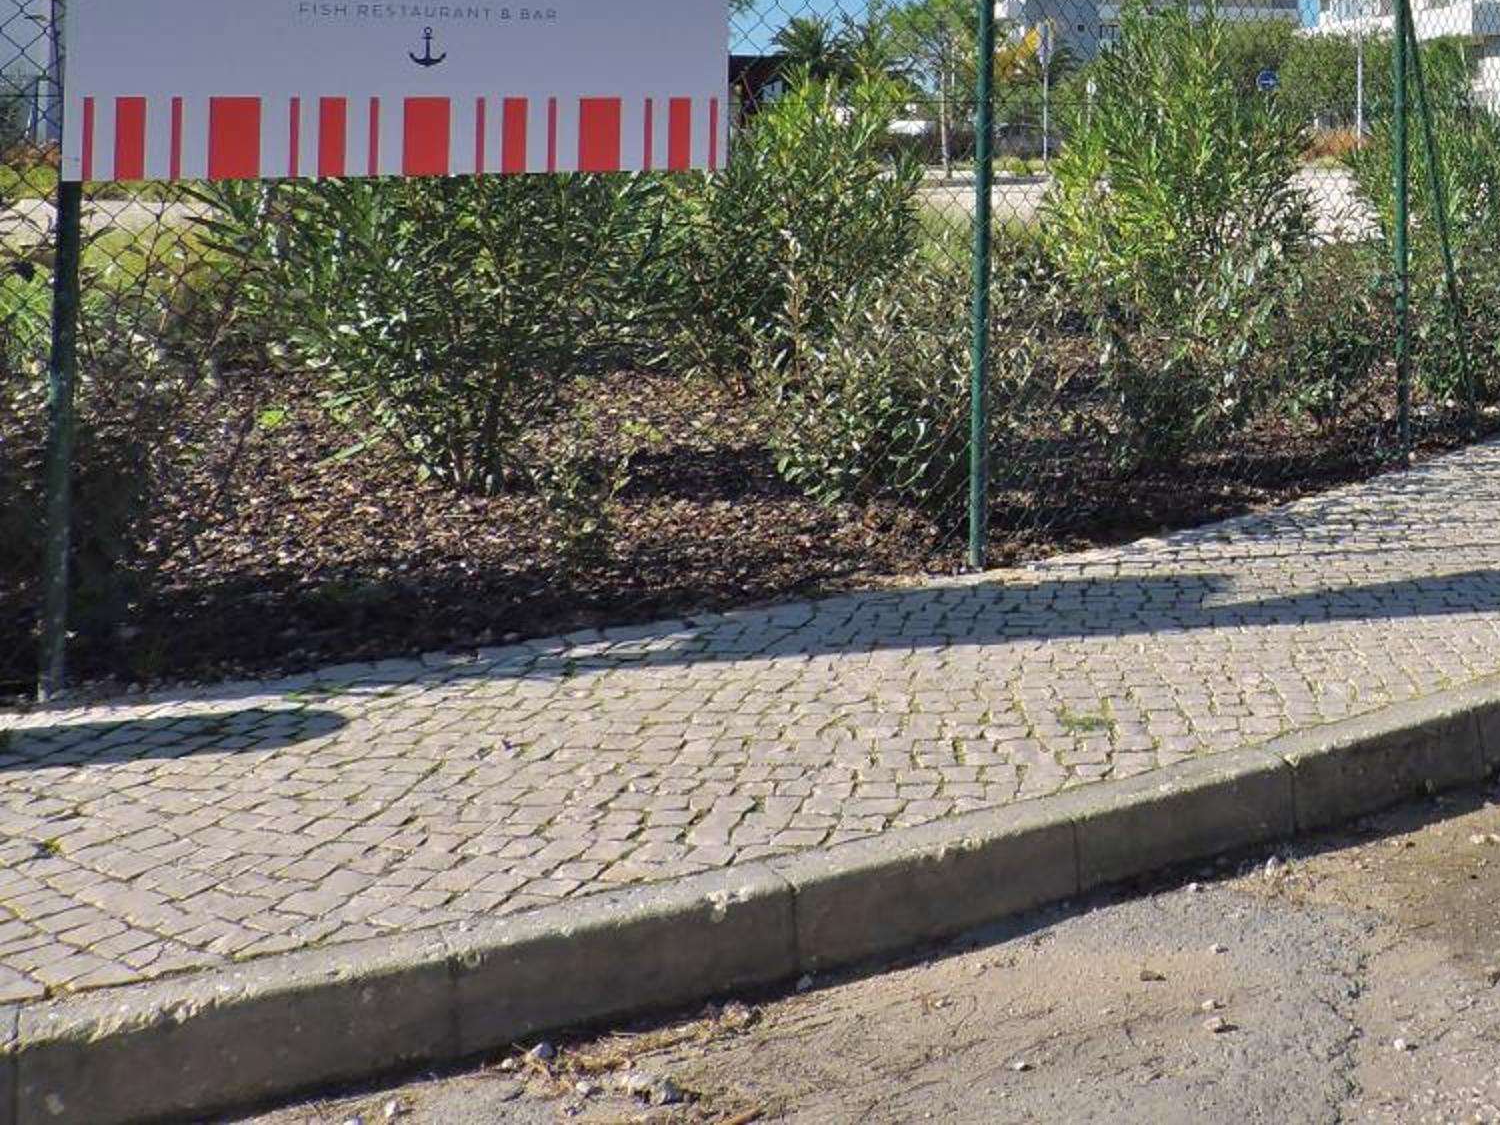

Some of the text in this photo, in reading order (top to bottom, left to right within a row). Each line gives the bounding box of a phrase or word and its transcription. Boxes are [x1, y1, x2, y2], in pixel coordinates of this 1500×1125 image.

[299, 1, 558, 21] FISH RESTAURANT & BAR
